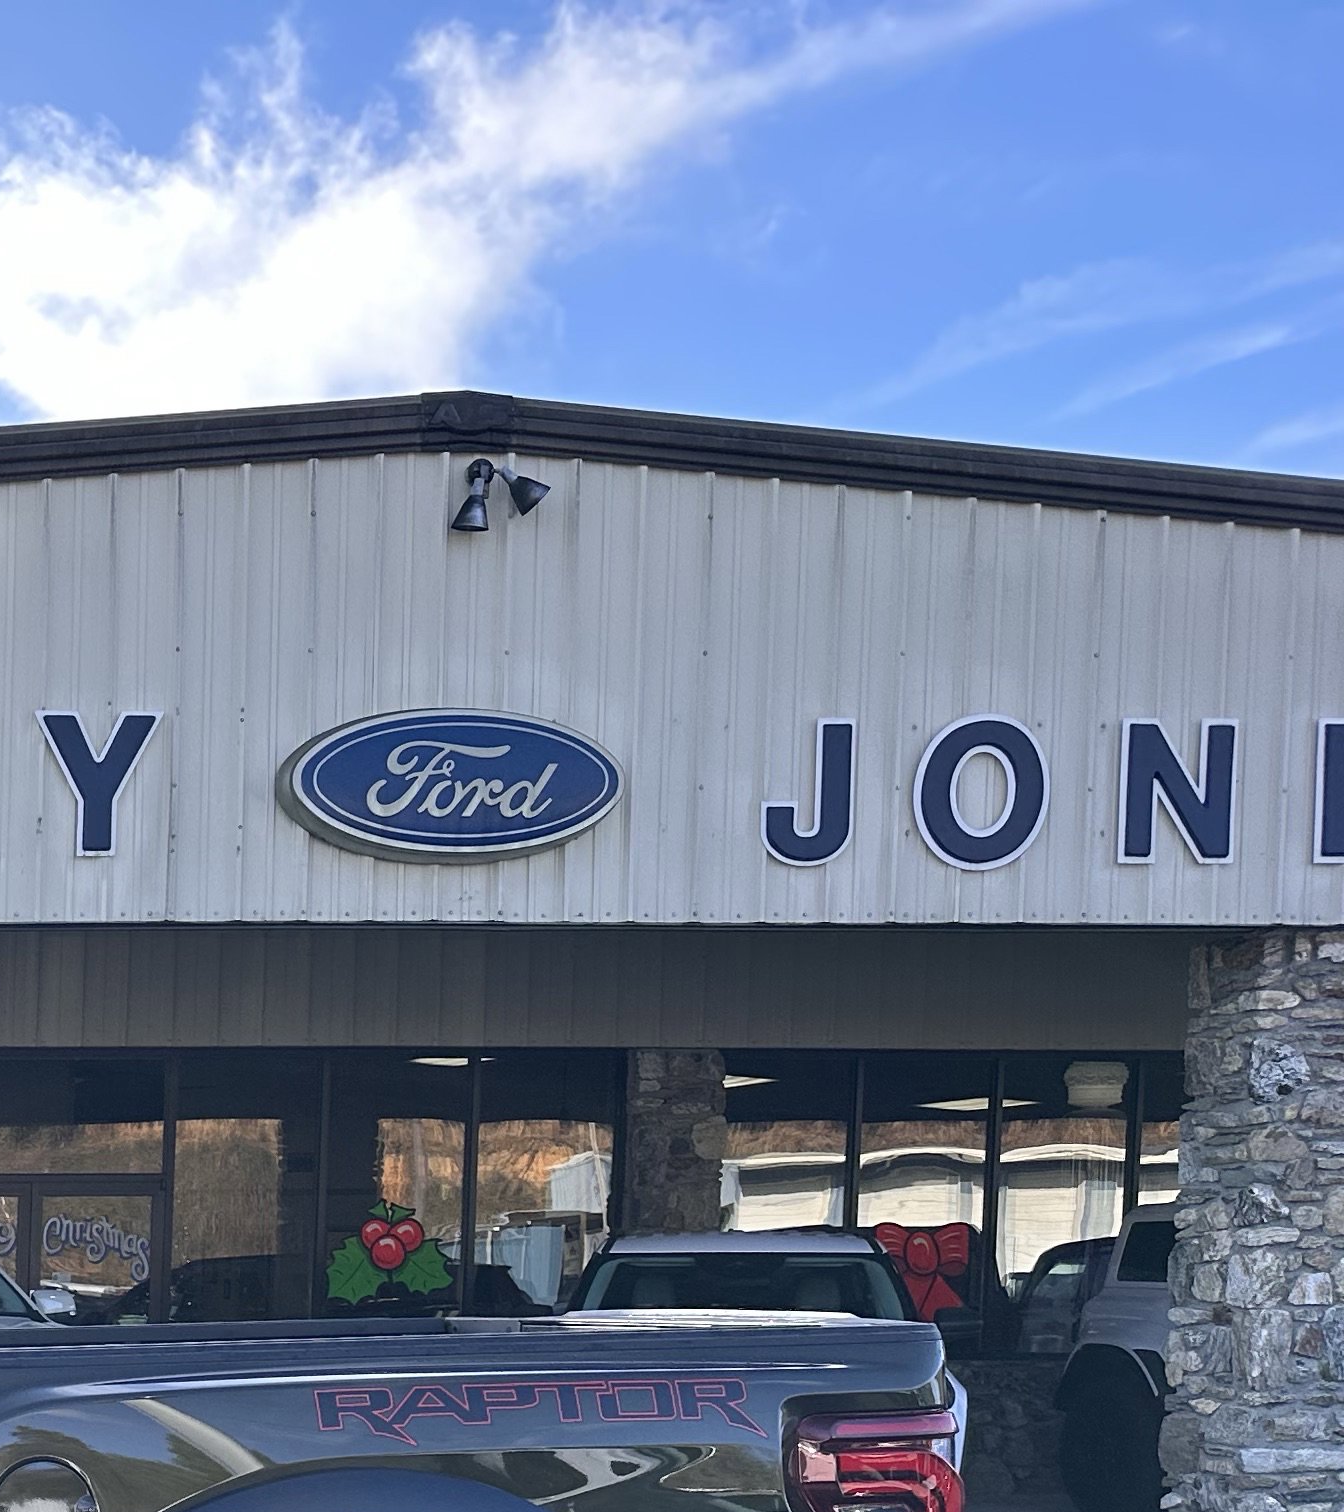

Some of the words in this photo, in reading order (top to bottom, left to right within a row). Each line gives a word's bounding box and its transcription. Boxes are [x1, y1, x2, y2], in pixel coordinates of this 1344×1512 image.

[366, 740, 559, 819] Ford
[761, 712, 1344, 871] JON
[43, 1213, 150, 1282] Christmas
[314, 1378, 768, 1446] RAPTOR
